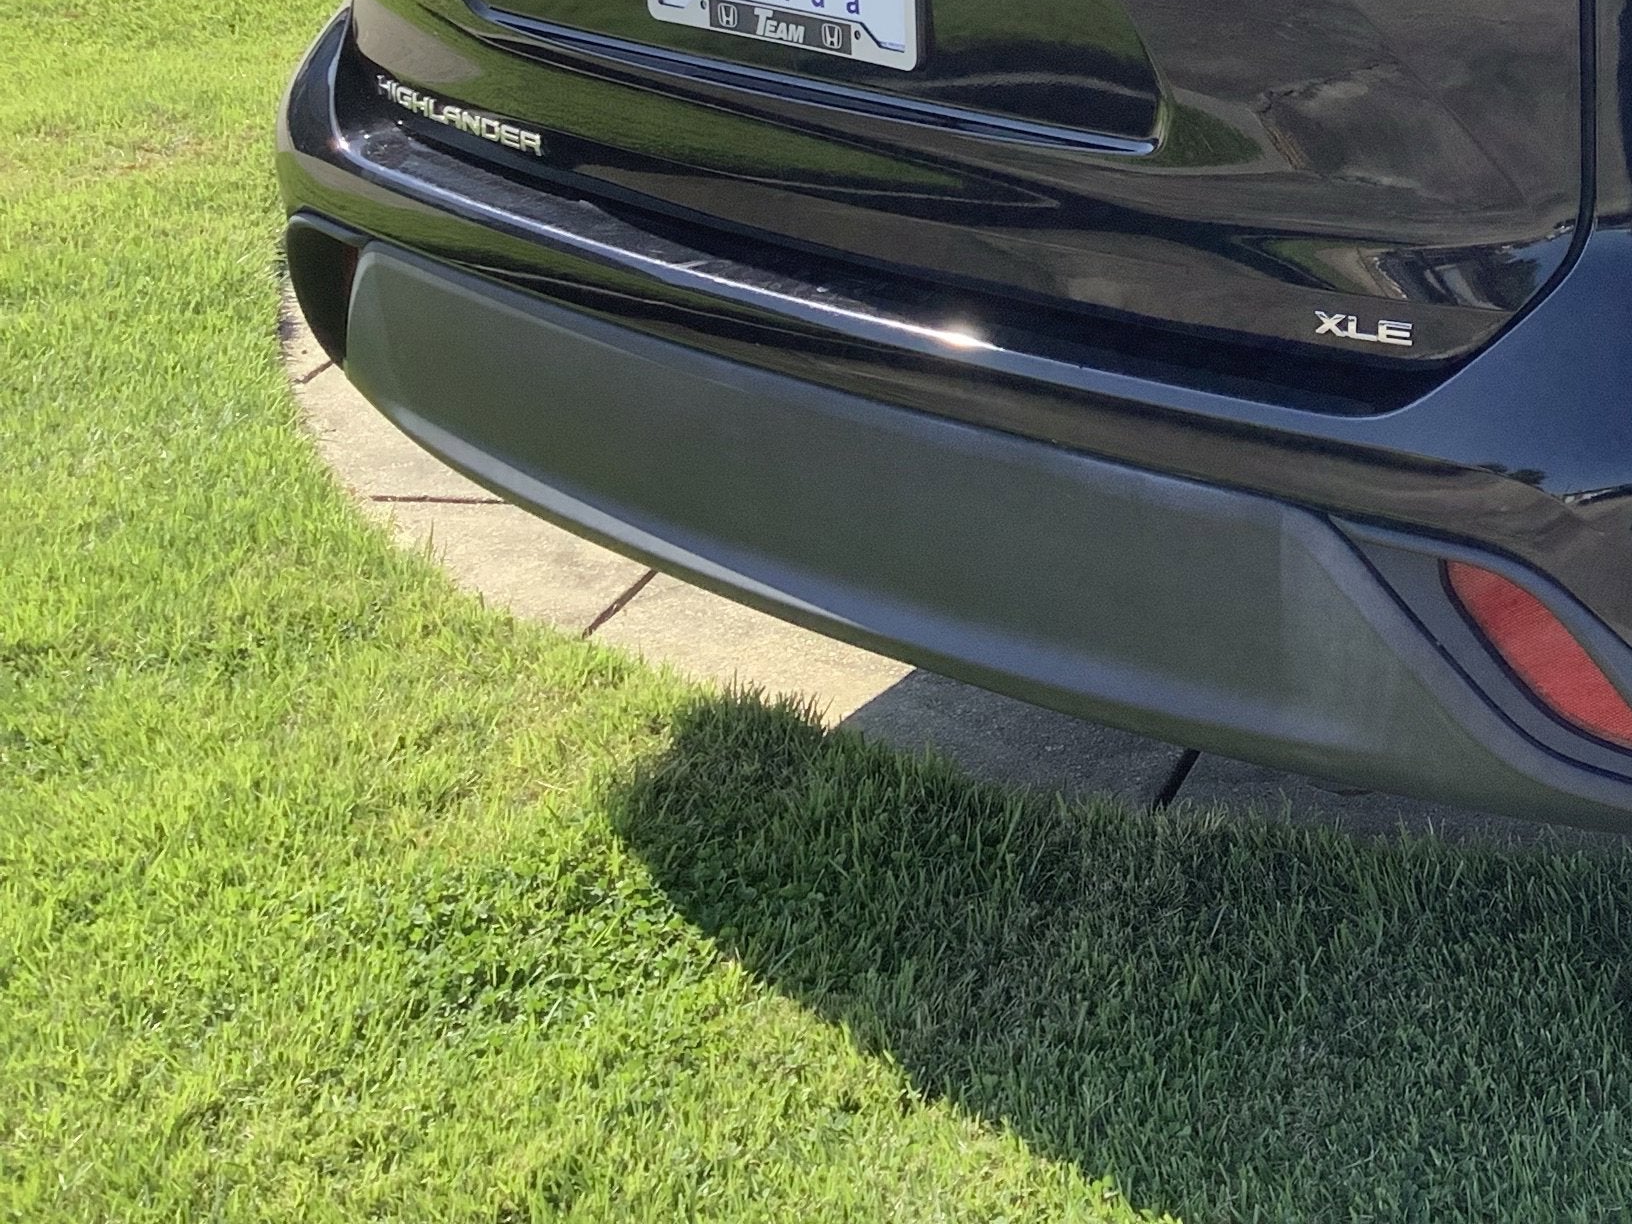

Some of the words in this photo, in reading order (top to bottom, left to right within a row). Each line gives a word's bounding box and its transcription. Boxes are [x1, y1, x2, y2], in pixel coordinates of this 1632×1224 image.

[754, 7, 805, 44] TEAM
[376, 74, 544, 157] HIGHLANDER
[1314, 310, 1413, 346] XLE
